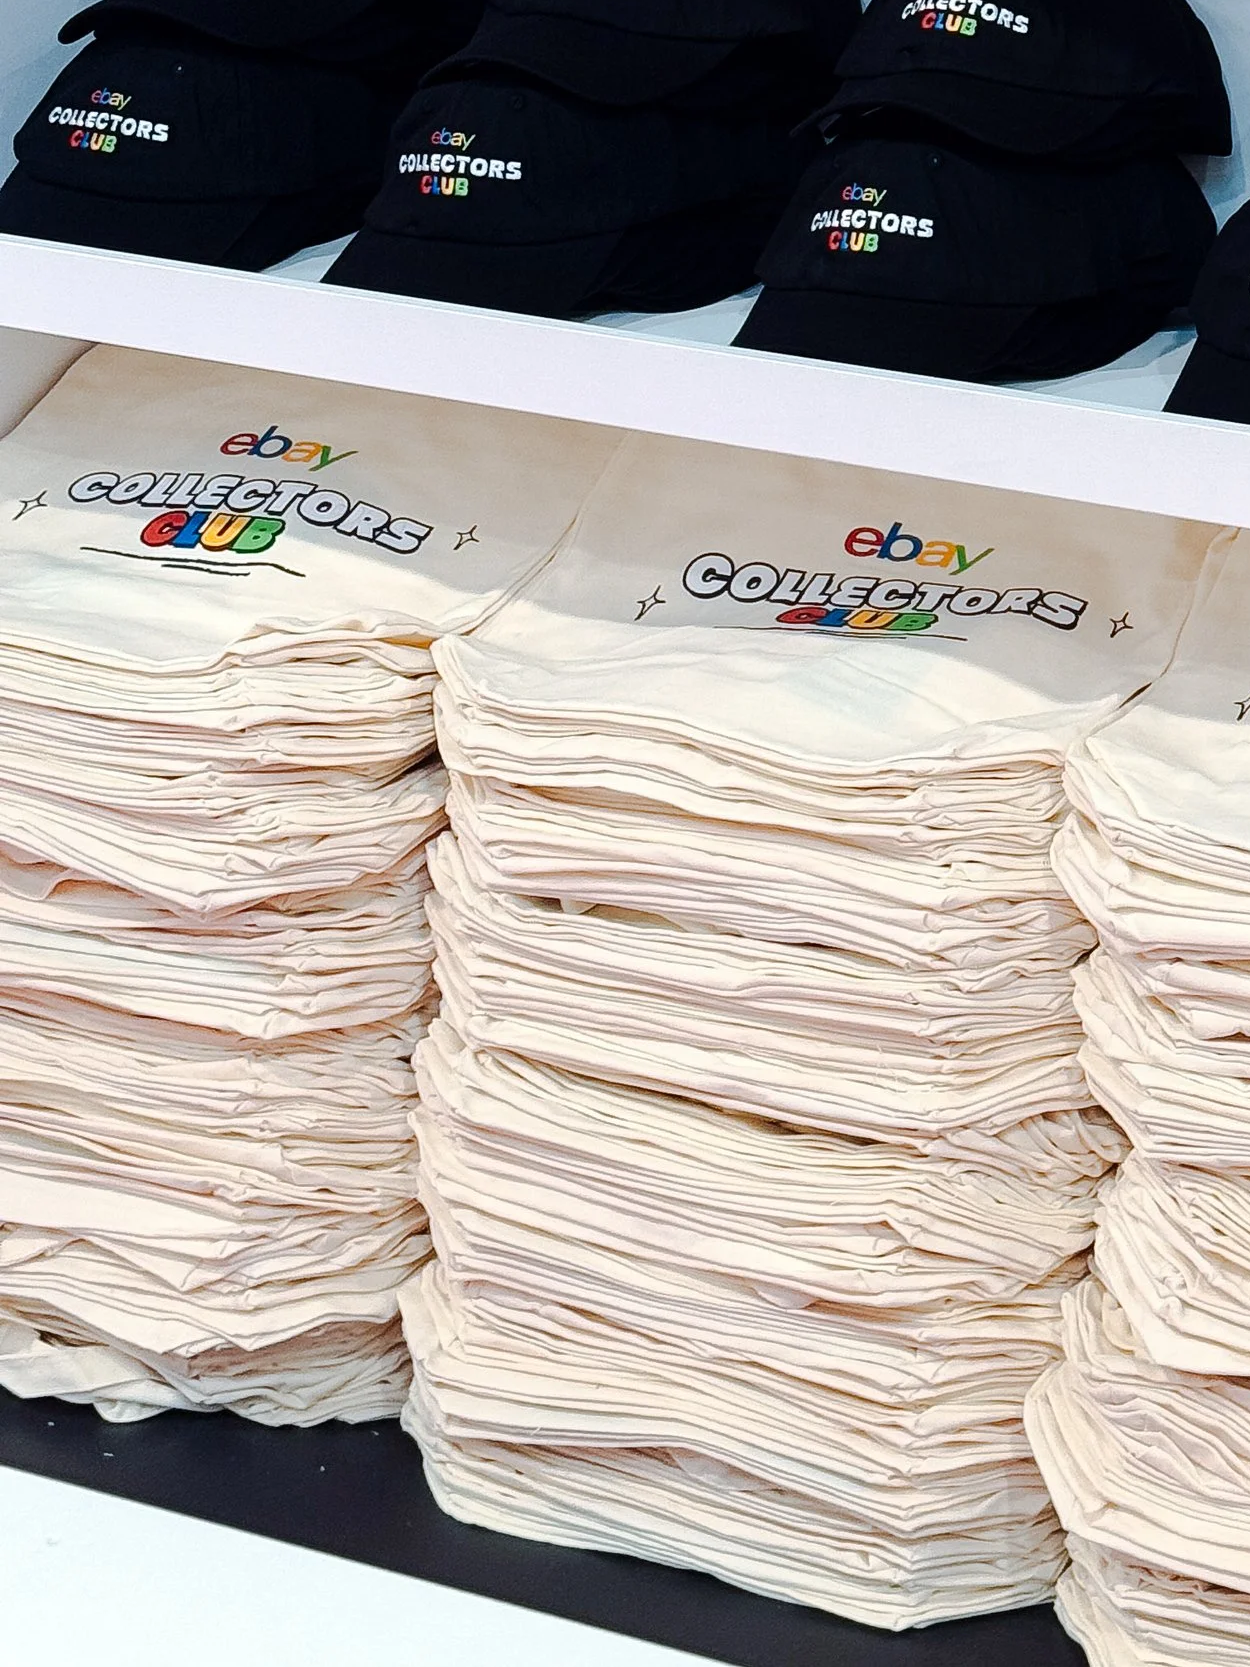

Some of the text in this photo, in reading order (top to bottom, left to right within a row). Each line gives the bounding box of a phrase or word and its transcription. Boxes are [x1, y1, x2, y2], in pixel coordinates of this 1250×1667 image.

[921, 12, 977, 36] CLUB
[91, 87, 132, 111] ebay
[48, 106, 169, 142] COLLECTORS
[69, 130, 117, 153] CLUB
[431, 127, 476, 151] ebay
[399, 153, 522, 180] COLLECTORS
[420, 175, 469, 196] CLUB
[842, 182, 888, 207] ebay
[810, 209, 934, 238] COLLECTORS
[828, 230, 879, 253] CLUB
[219, 425, 358, 471] ebay
[68, 472, 434, 555] COLLECTORS
[140, 510, 287, 554] CLUB
[843, 521, 994, 575] ebay
[683, 552, 1089, 630] COLLECTORS
[776, 607, 939, 631] CLUB
